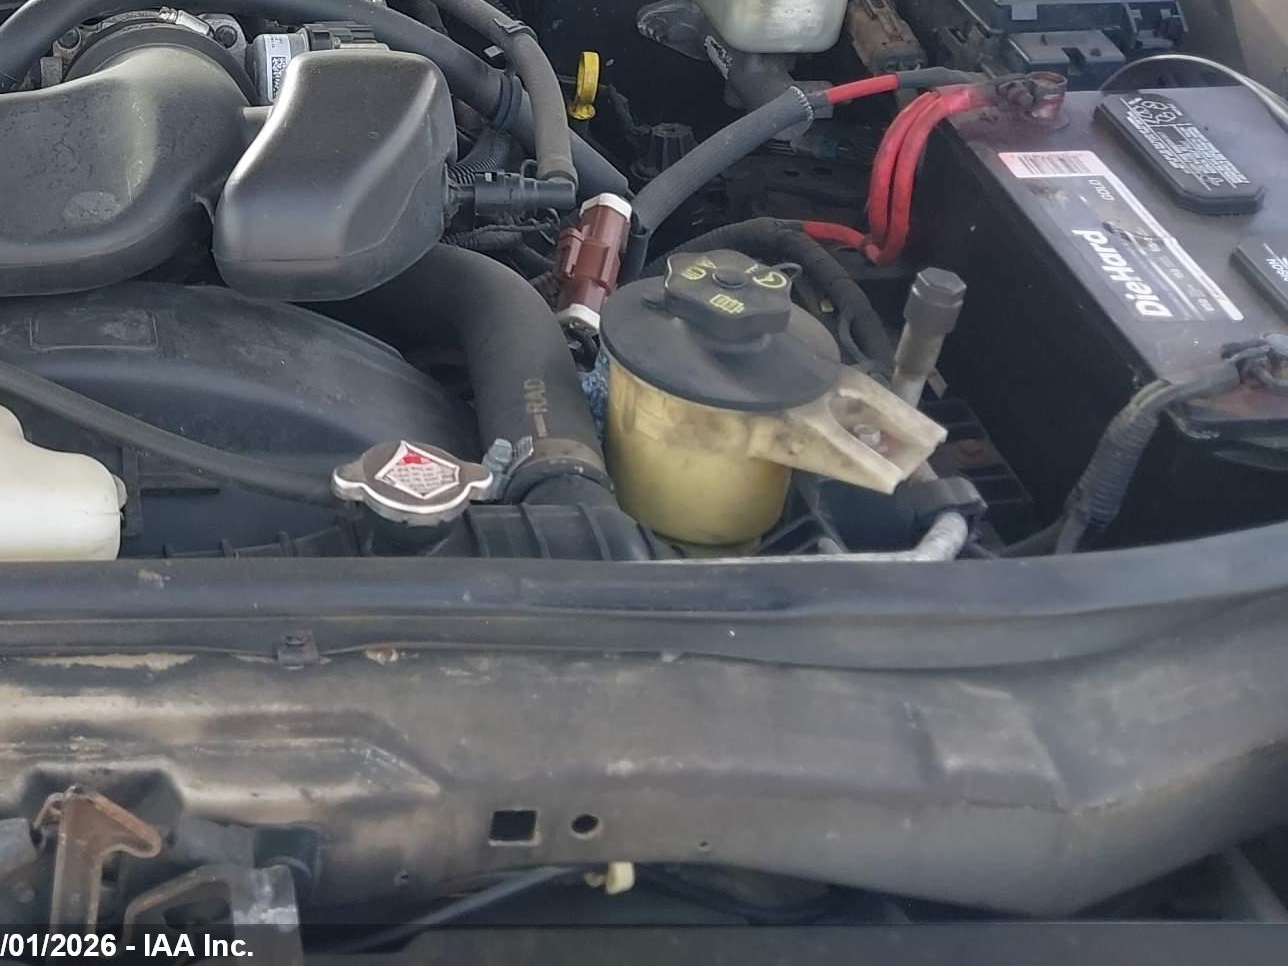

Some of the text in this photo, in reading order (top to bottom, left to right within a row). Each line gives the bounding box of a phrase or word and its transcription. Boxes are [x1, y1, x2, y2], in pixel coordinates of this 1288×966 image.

[1087, 178, 1116, 201] GOLD
[1071, 228, 1174, 317] DieHard
[523, 378, 549, 413] RAD
